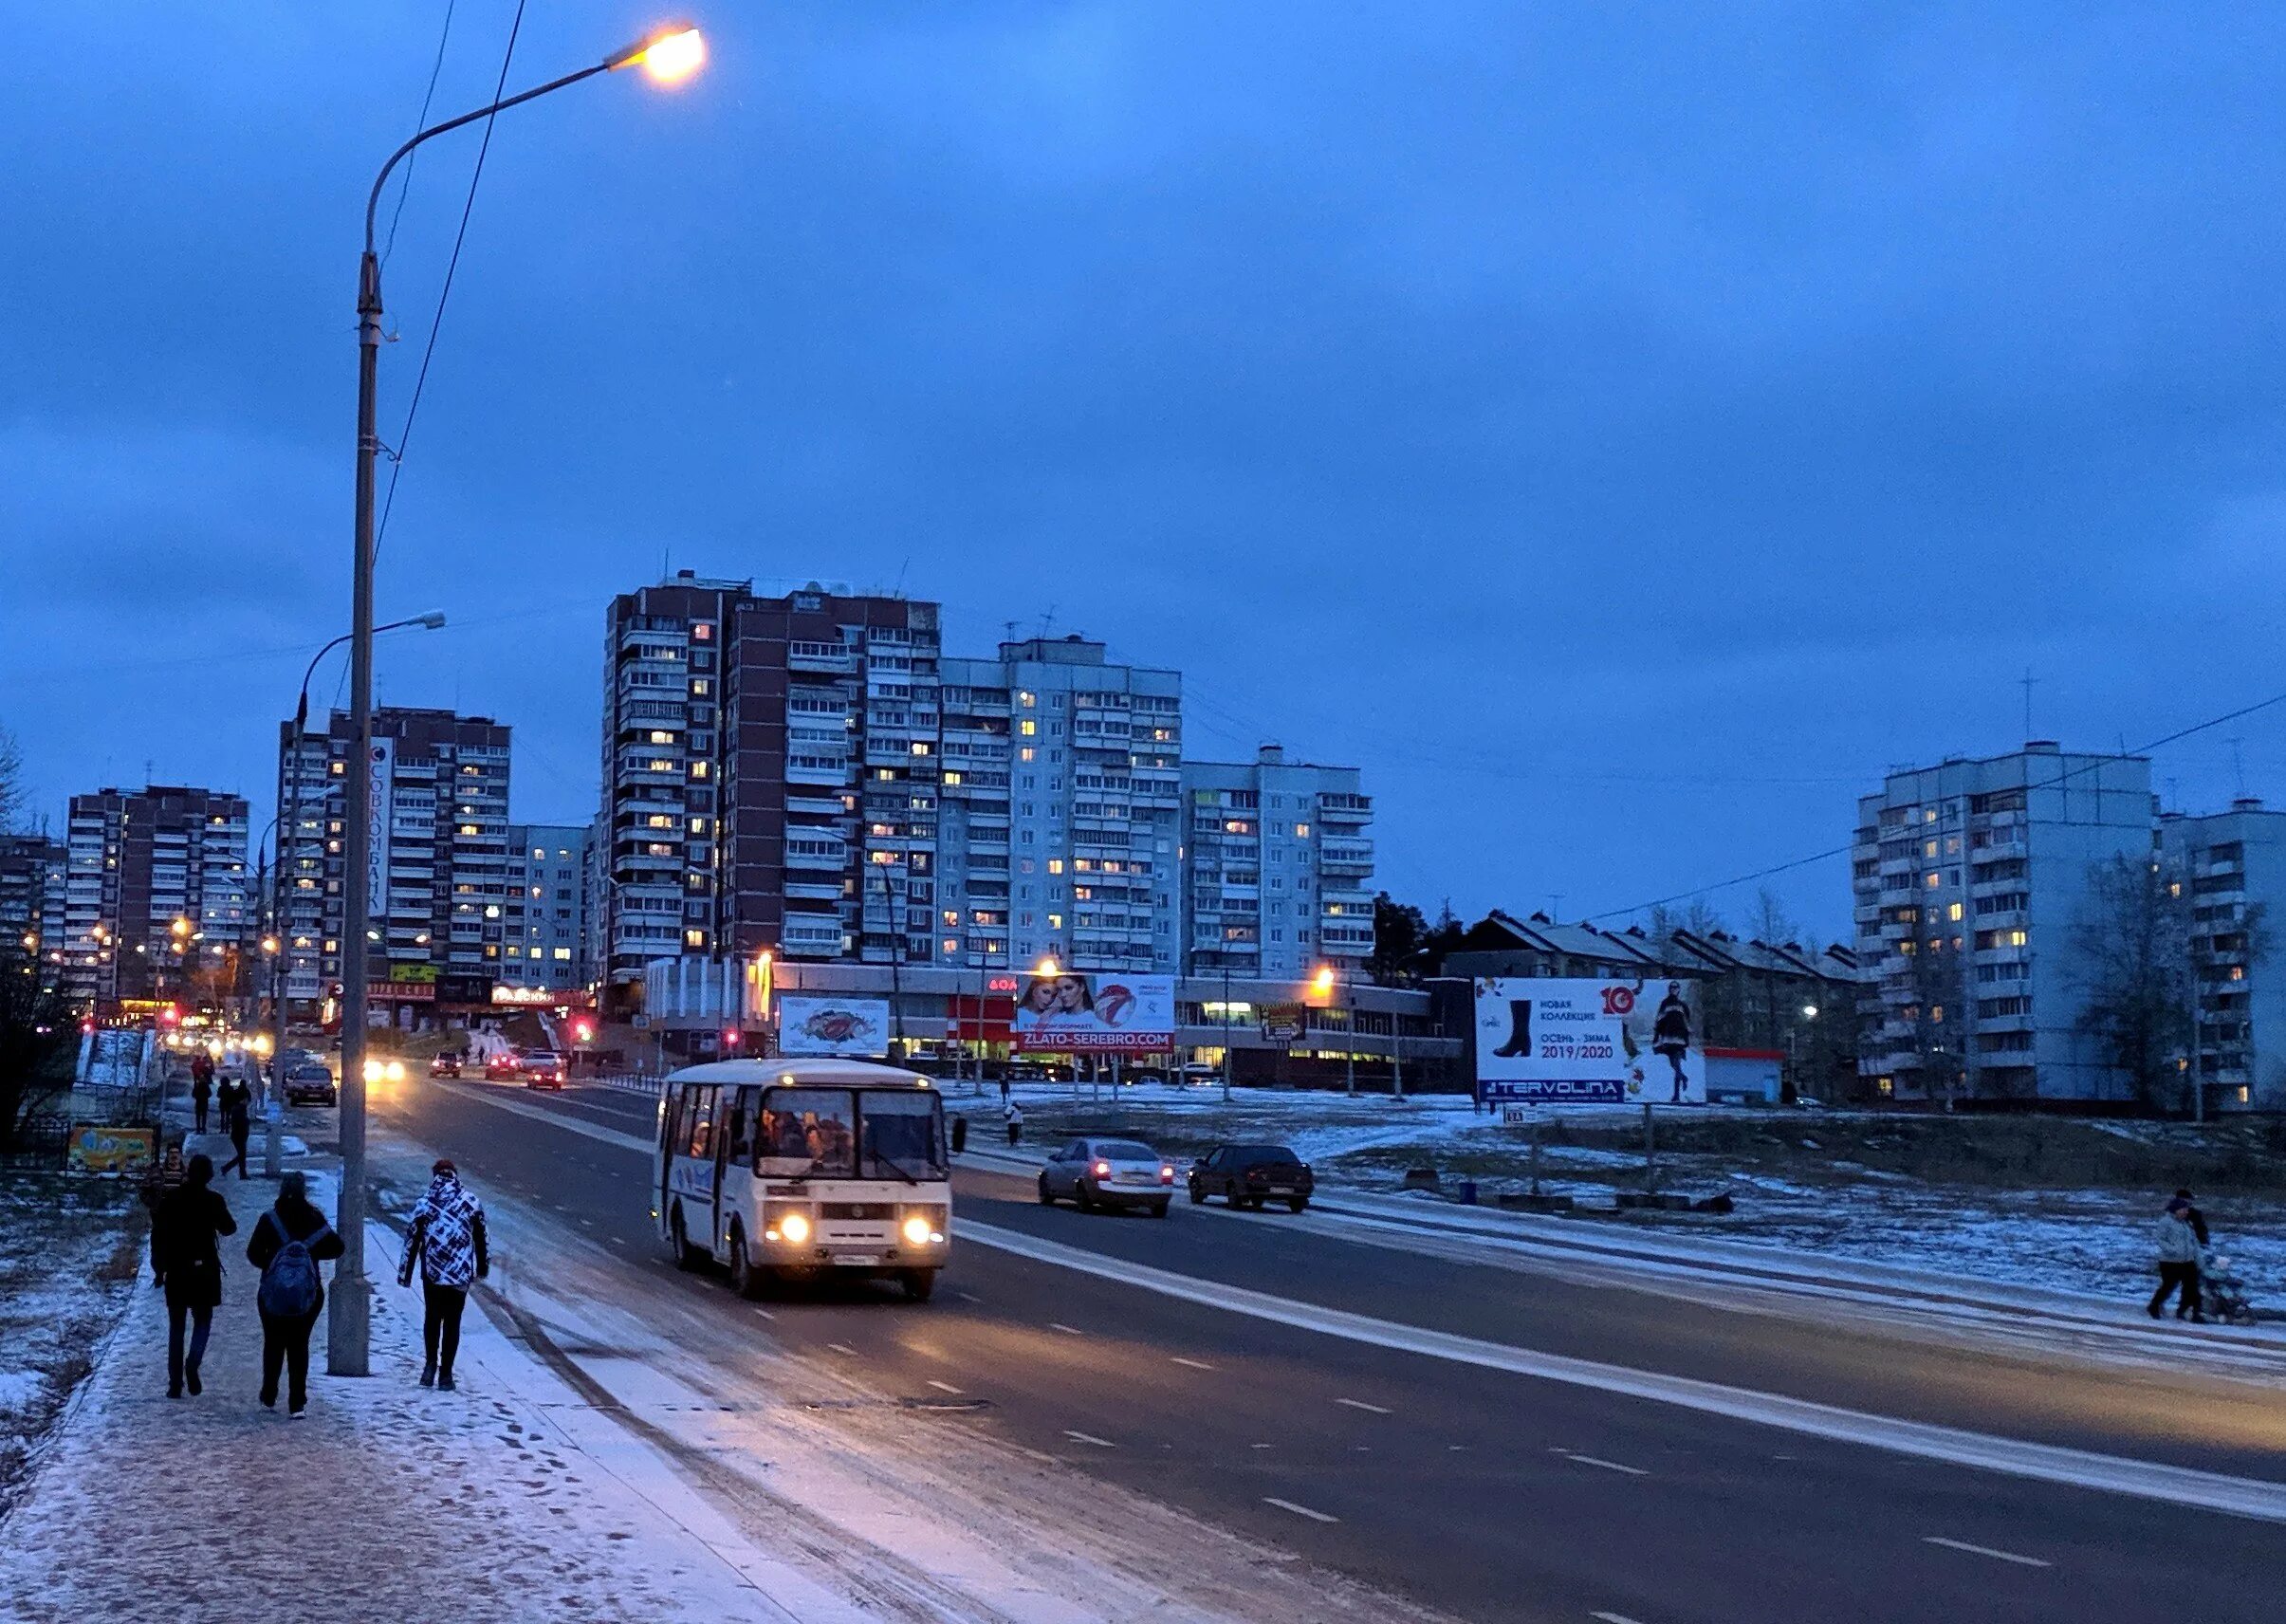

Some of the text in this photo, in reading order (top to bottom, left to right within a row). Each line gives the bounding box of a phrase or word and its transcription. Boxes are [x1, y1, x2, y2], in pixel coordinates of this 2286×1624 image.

[368, 765, 383, 909] СОВКОМБАНК
[1540, 1012, 1595, 1021] КОЛЛЕКЦИЯ
[1024, 1033, 1169, 1044] ZLATO-SEREBRO.COM
[1540, 1034, 1575, 1043] ОСЕНЬ
[1583, 1034, 1611, 1043] ЗИМА
[1541, 1045, 1613, 1060] 2019/2020
